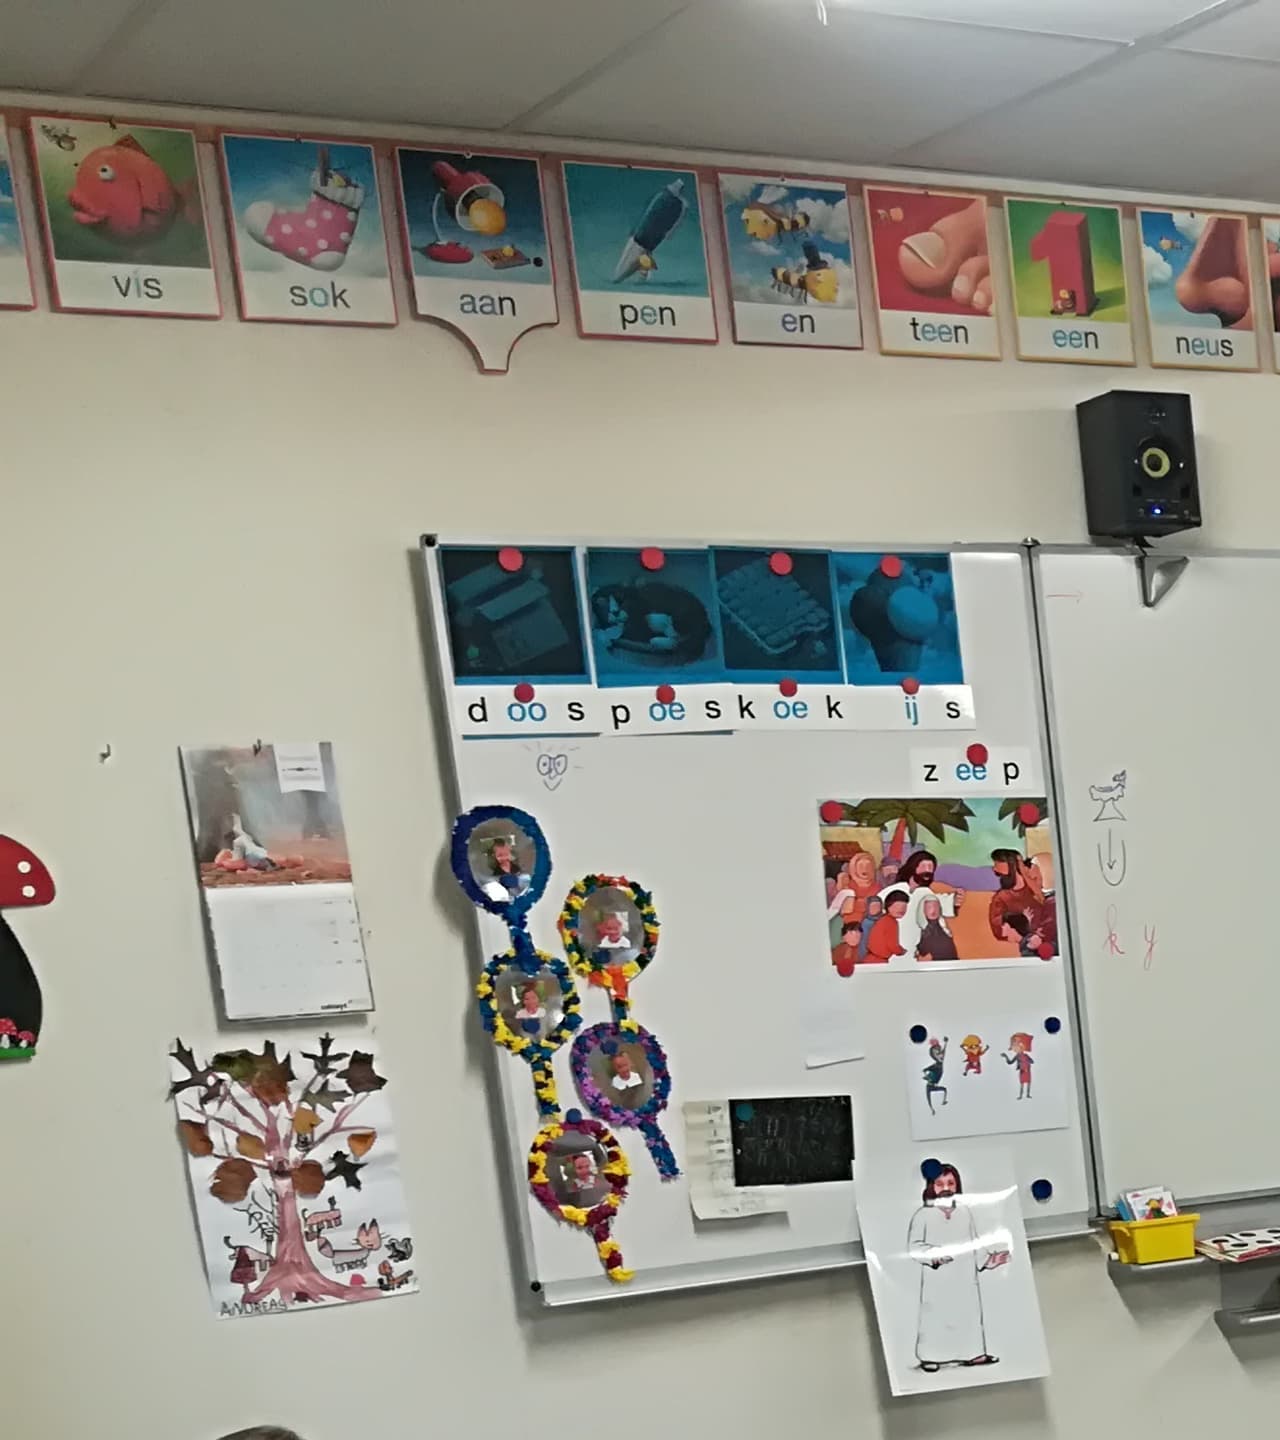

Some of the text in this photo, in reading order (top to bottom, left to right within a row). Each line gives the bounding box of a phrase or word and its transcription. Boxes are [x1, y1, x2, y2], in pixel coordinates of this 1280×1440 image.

[113, 272, 163, 301] vis
[289, 280, 351, 309] sok
[459, 292, 517, 318] aan
[620, 302, 678, 330] pen
[781, 313, 816, 335] en
[909, 316, 969, 346] teen
[1052, 329, 1099, 350] een
[1175, 333, 1235, 358] neus
